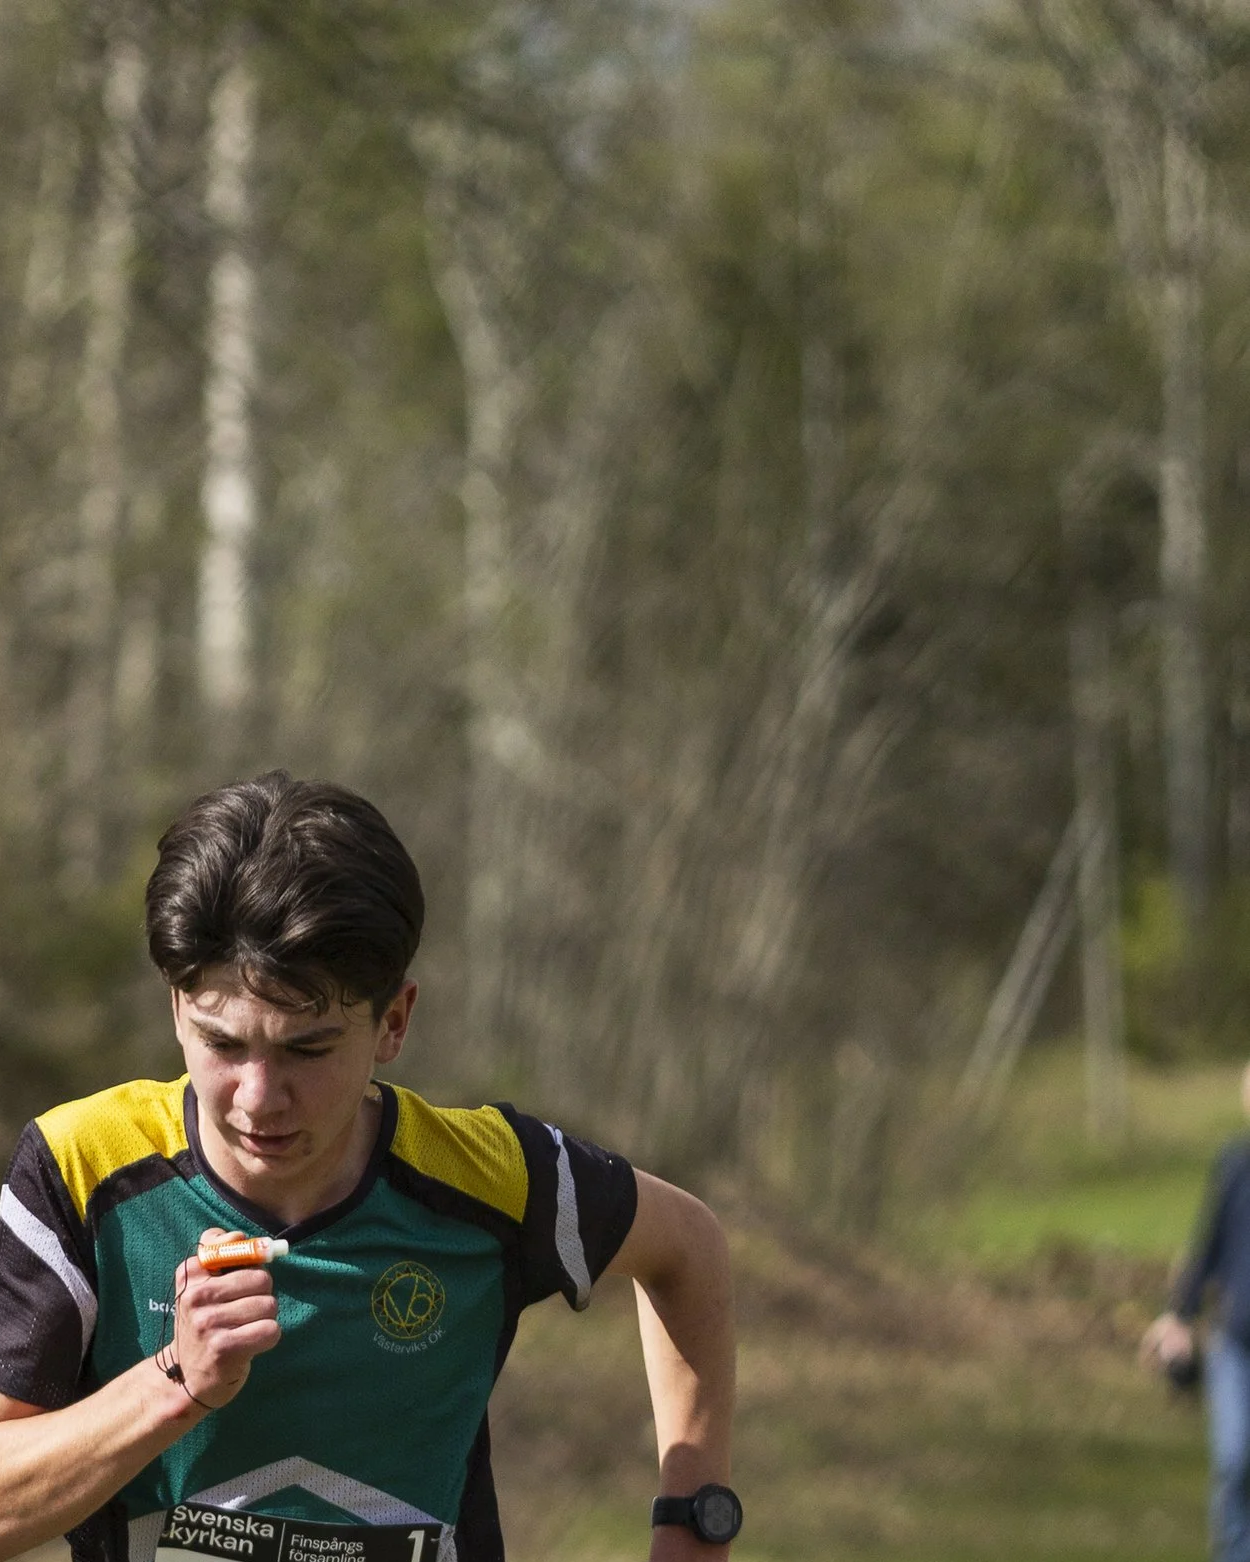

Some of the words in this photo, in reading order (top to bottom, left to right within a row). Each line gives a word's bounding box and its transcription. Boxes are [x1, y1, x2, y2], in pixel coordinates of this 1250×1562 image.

[373, 1331, 428, 1354] Västerviks
[428, 1325, 447, 1344] OK
[172, 1505, 275, 1538] Svenska
[169, 1522, 254, 1554] kyrkan
[291, 1534, 364, 1554] Finspångs
